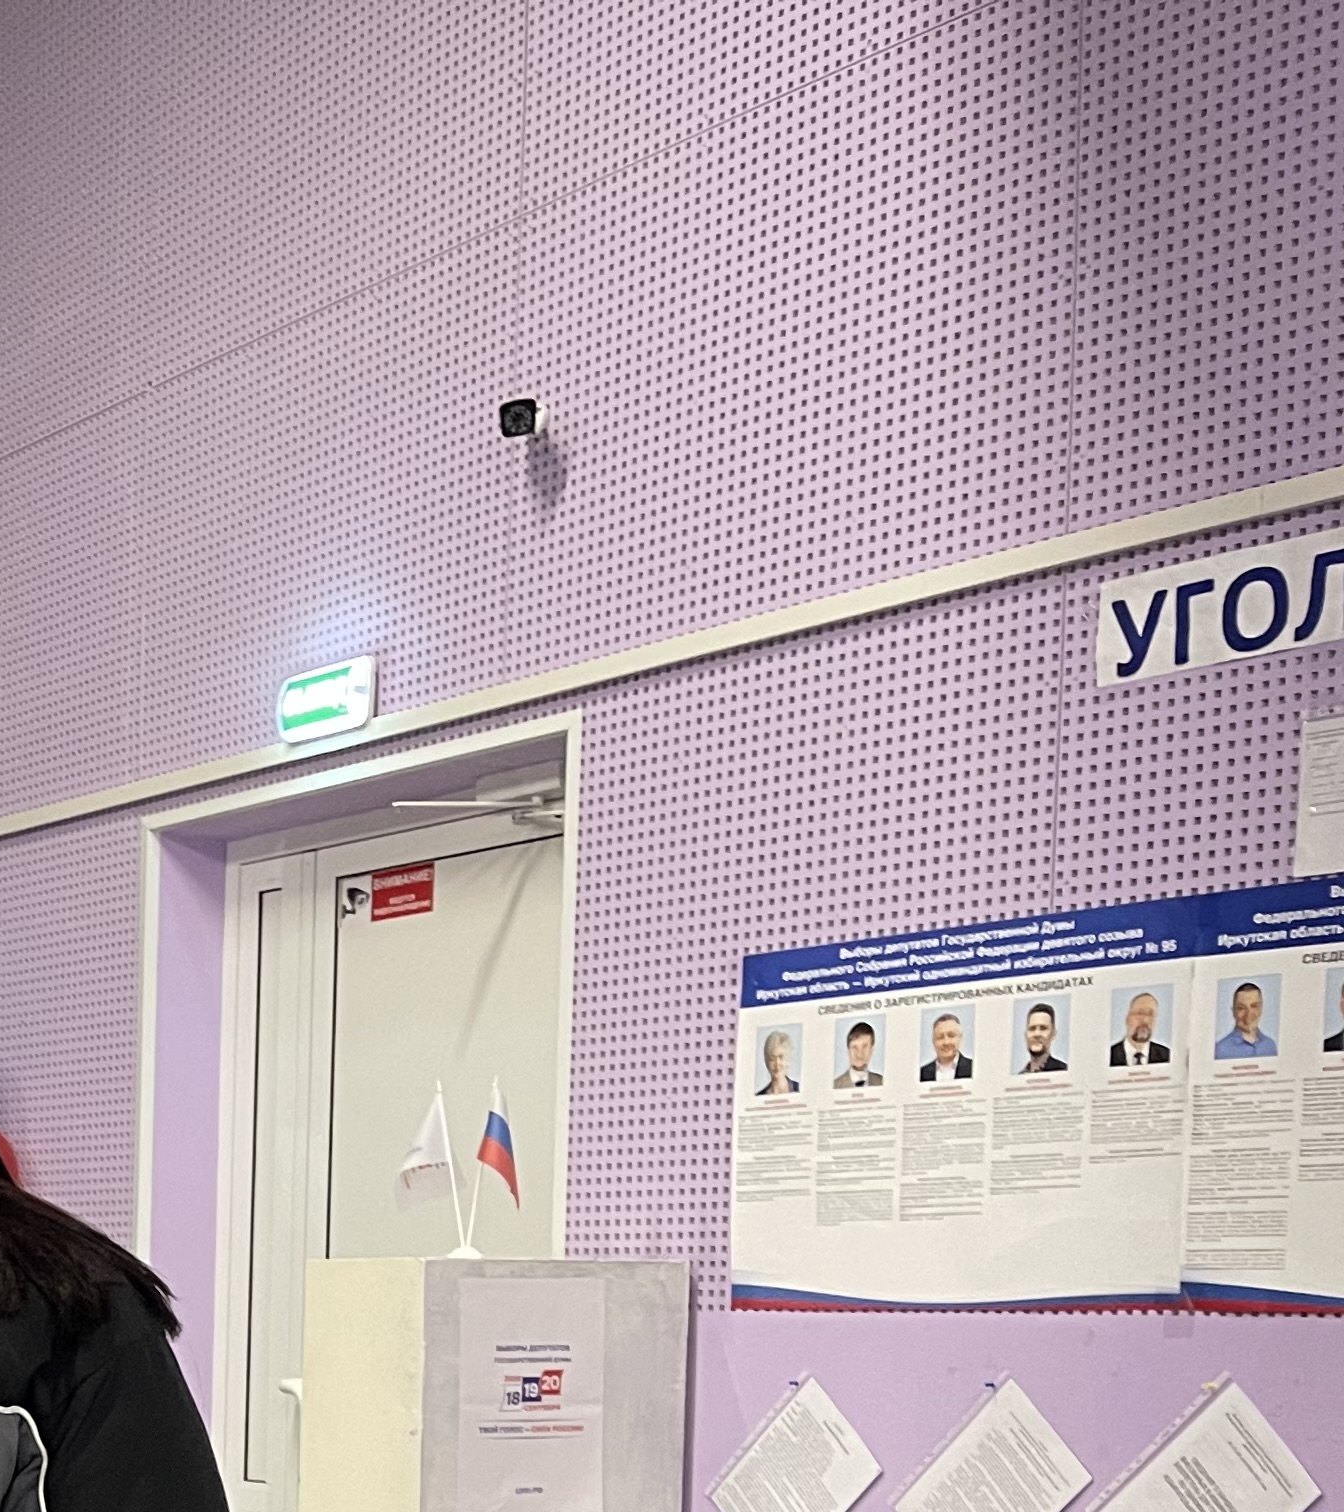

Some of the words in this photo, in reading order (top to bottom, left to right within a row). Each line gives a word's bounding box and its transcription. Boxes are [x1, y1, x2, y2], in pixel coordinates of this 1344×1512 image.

[506, 1391, 520, 1406] 18
[523, 1382, 539, 1398] 19
[541, 1375, 560, 1390] 20
